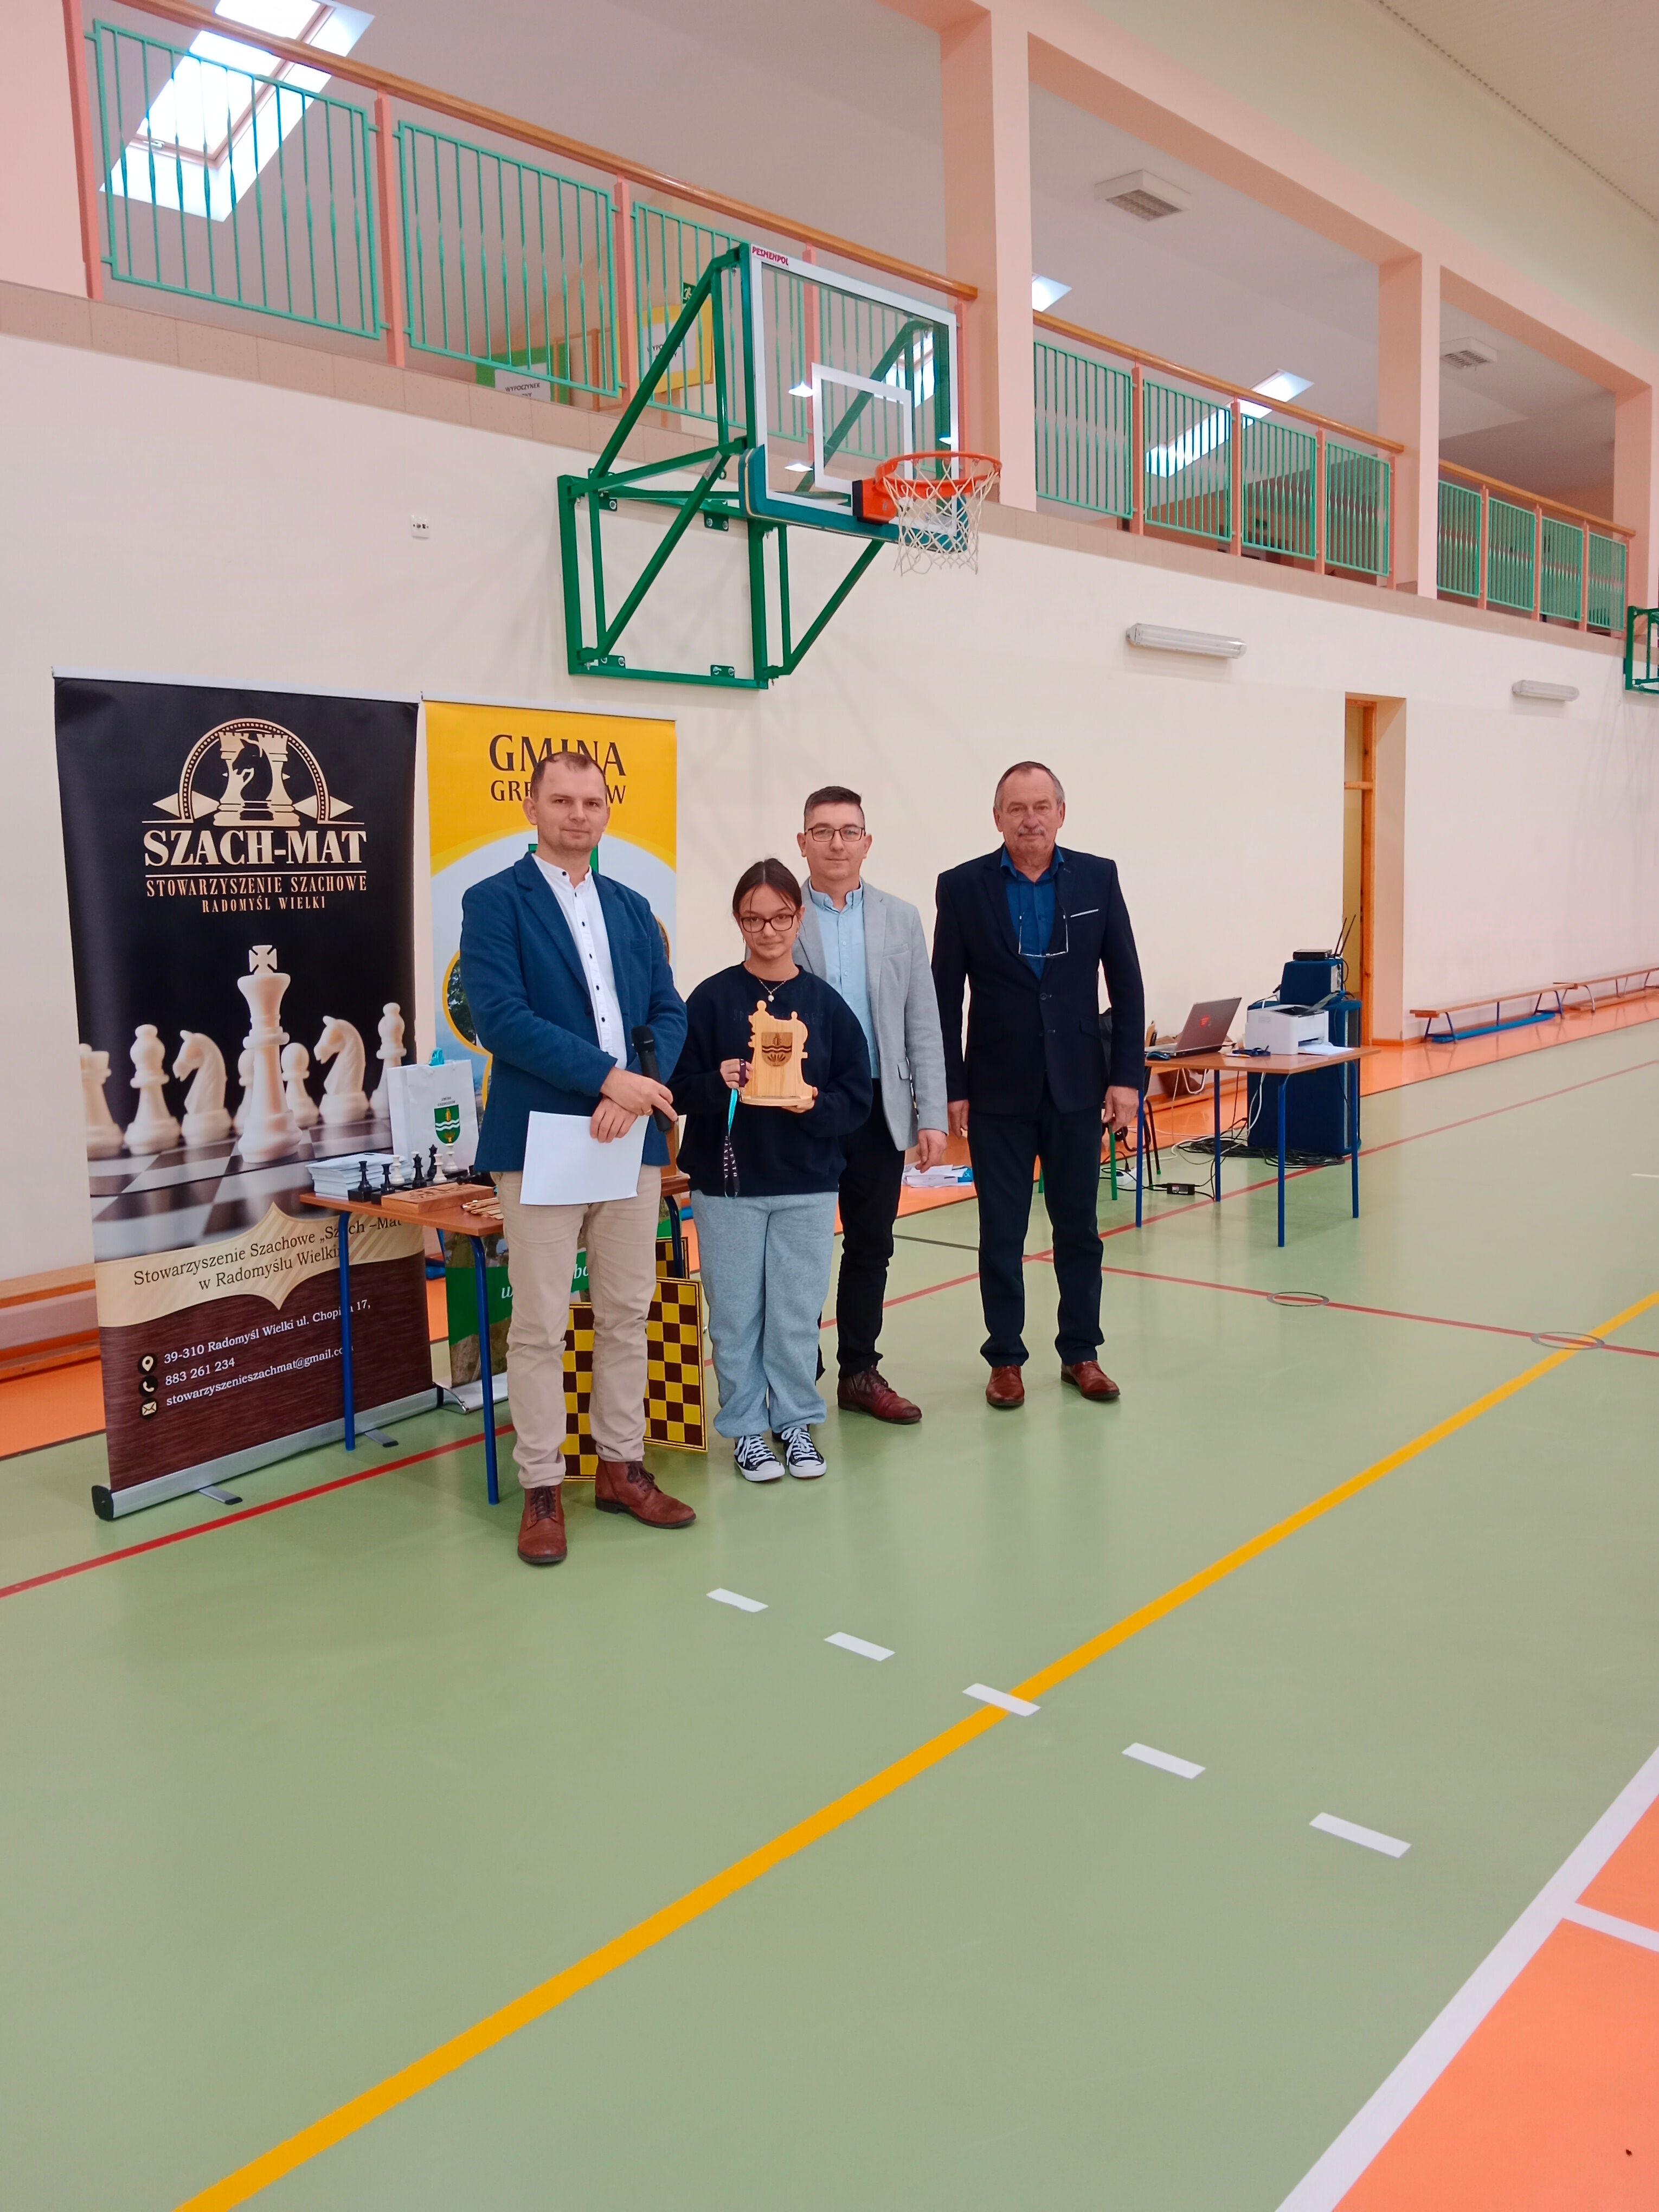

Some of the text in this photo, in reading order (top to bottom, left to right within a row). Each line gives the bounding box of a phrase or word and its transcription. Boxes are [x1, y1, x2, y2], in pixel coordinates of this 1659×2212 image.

[505, 383, 540, 391] WYPOCZYNEK
[143, 829, 367, 866] SZACH-MAT
[146, 876, 366, 897] STOWARZYSZENIE SZACHOWE
[202, 895, 325, 913] RADOMYŚL WIELKI
[134, 1248, 246, 1285] Stowarzyszenie
[250, 1233, 315, 1257] Szachowe
[320, 1220, 365, 1243] „Szch
[198, 1245, 339, 1290] w Radomyślu Wielki
[164, 1300, 370, 1364] 39-310 Radomyśl Wielki ul. Chopi 17,
[165, 1358, 235, 1385] 883 261 234
[166, 1346, 353, 1406] stowarzyszenieszachmat@gmail.co
